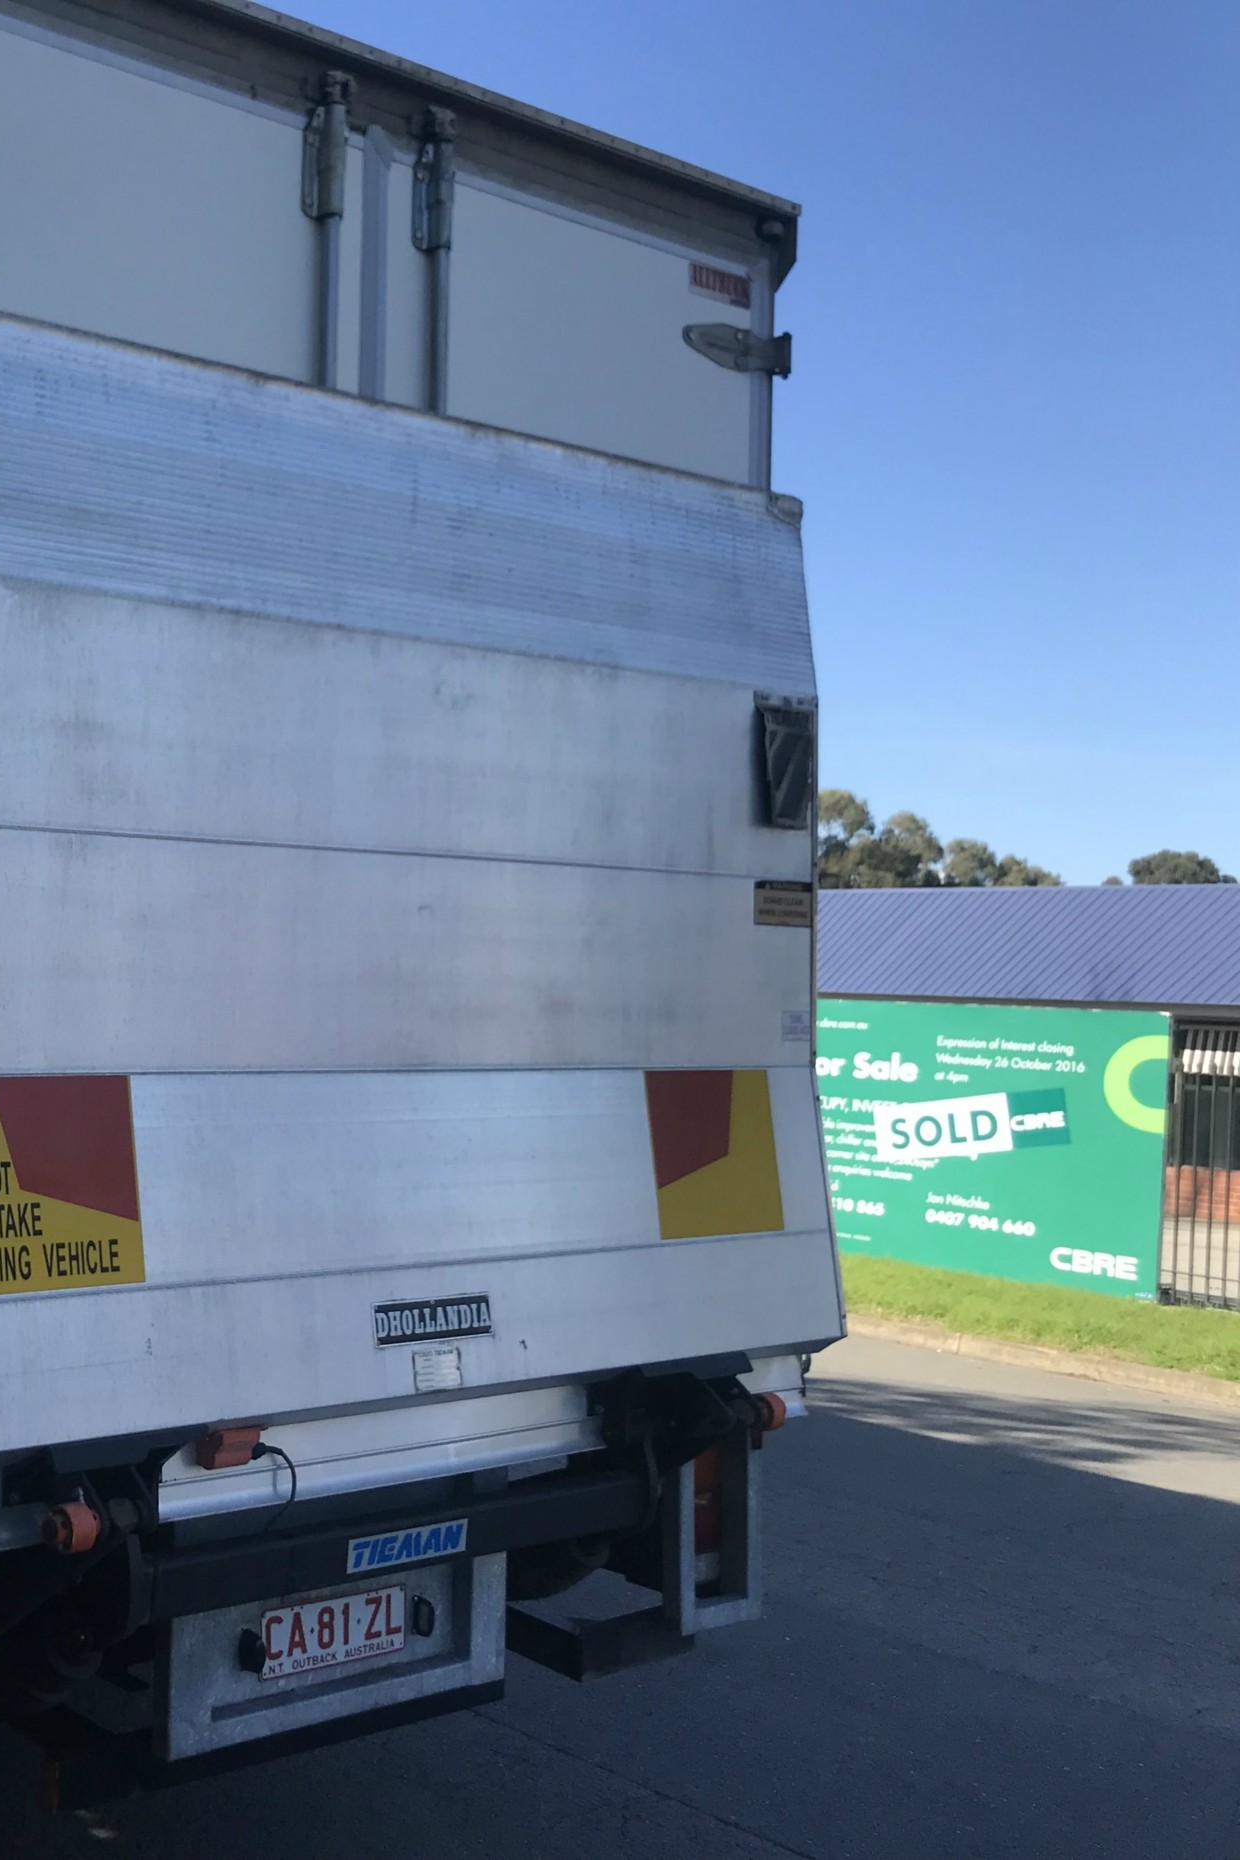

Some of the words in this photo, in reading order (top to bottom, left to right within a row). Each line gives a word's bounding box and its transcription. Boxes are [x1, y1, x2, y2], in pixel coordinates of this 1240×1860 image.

[936, 1035, 987, 1050] Expression
[988, 1037, 1000, 1050] of
[1001, 1039, 1036, 1052] Interest
[1037, 1041, 1074, 1057] closing
[815, 1056, 846, 1077] or
[852, 1051, 919, 1083] Sale
[934, 1071, 945, 1081] at
[935, 1052, 992, 1069] Wednesday
[994, 1055, 1009, 1068] 26
[1010, 1057, 1053, 1071] October
[1055, 1060, 1086, 1073] 2016
[890, 1110, 998, 1149] SOLD
[1010, 1110, 1066, 1131] CBRE
[832, 1164, 871, 1177] enquiries
[872, 1167, 913, 1181] welcome
[831, 1197, 855, 1212] 10
[925, 1208, 965, 1226] 0407
[967, 1214, 999, 1231] 904
[1002, 1218, 1036, 1237] 660
[42, 1239, 120, 1277] VEHICLE
[1049, 1246, 1139, 1281] CBRE
[375, 1302, 492, 1338] DHOLLANDIA
[352, 1523, 464, 1568] TIEMAN
[292, 1652, 338, 1670] OUTBACK
[344, 1638, 396, 1659] AUSTRALIA
